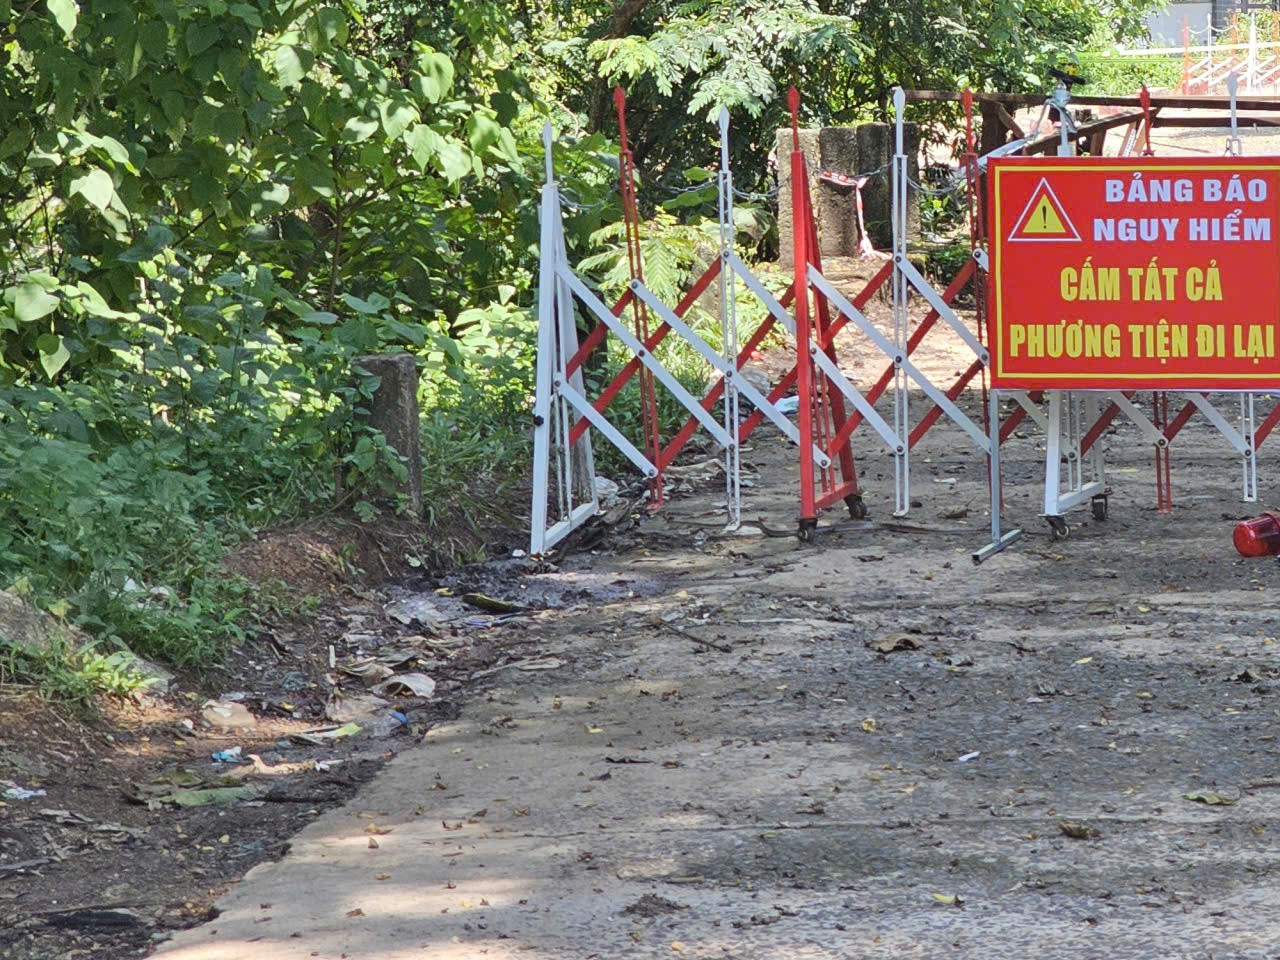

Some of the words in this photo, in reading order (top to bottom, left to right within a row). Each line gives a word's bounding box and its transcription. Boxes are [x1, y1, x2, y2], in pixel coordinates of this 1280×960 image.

[1105, 171, 1194, 203] BẢNG
[1203, 174, 1268, 203] BÁO
[1093, 218, 1180, 242] NGUY
[1188, 208, 1271, 242] HIỂM
[1060, 256, 1121, 302] CẤM
[1127, 256, 1179, 302] TẤT
[1185, 259, 1224, 302] CẢ
[1009, 319, 1121, 358] PHƯƠNG
[1128, 318, 1189, 365] TIỆN
[1195, 324, 1226, 358] ĐI
[1233, 324, 1276, 365] LẠI
